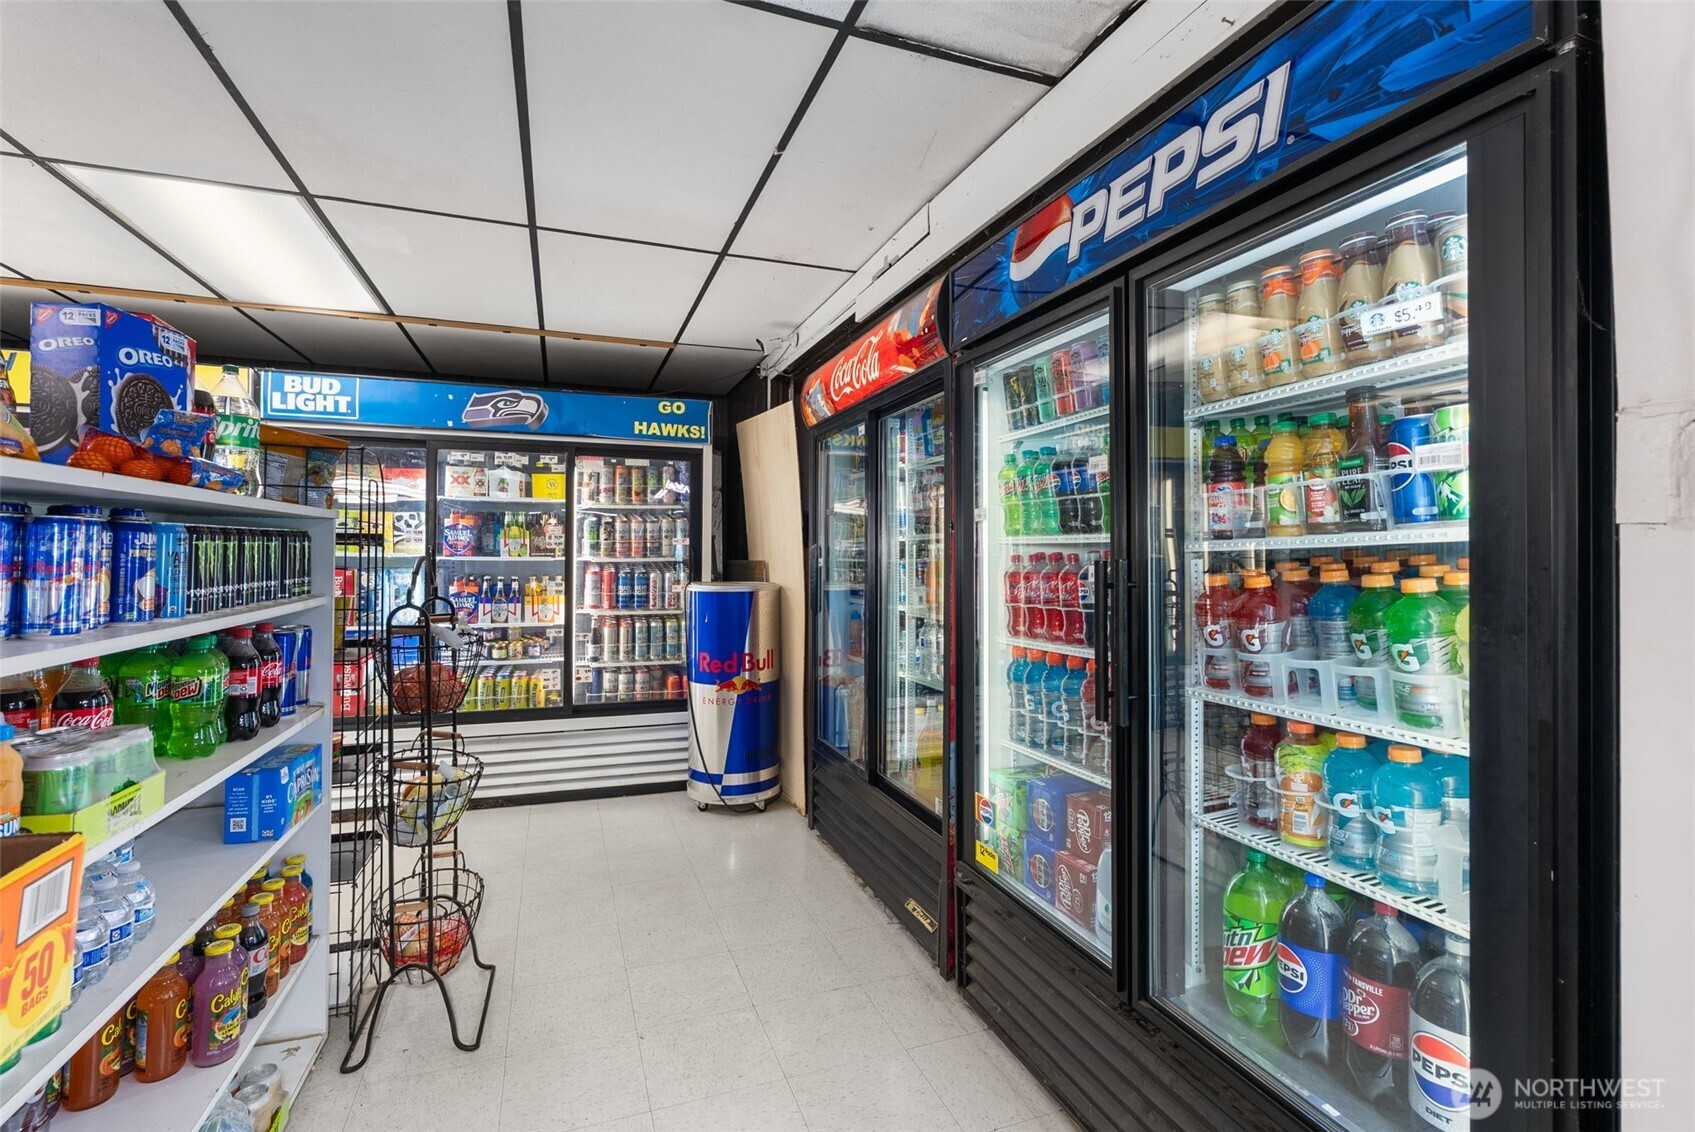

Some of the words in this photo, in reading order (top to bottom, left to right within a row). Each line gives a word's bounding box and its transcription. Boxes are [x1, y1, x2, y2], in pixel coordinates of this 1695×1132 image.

[1068, 61, 1291, 264] PEPSI
[62, 312, 74, 320] 12
[38, 337, 94, 351] OREO
[162, 334, 170, 345] 12
[118, 348, 173, 368] OREO
[830, 328, 886, 402] Coca-Cola
[284, 376, 341, 395] BUD
[272, 394, 350, 413] LIGHT
[659, 402, 686, 414] GO
[634, 421, 706, 438] HAWKS!
[699, 652, 738, 674] Red
[742, 648, 774, 672] Bull
[703, 696, 741, 706] ENERGY
[22, 941, 54, 1000] 50
[1352, 976, 1383, 996] FANSVILLE
[21, 986, 48, 1018] BAGS
[1412, 1048, 1470, 1089] PEPS
[1426, 1106, 1452, 1124] DIET
